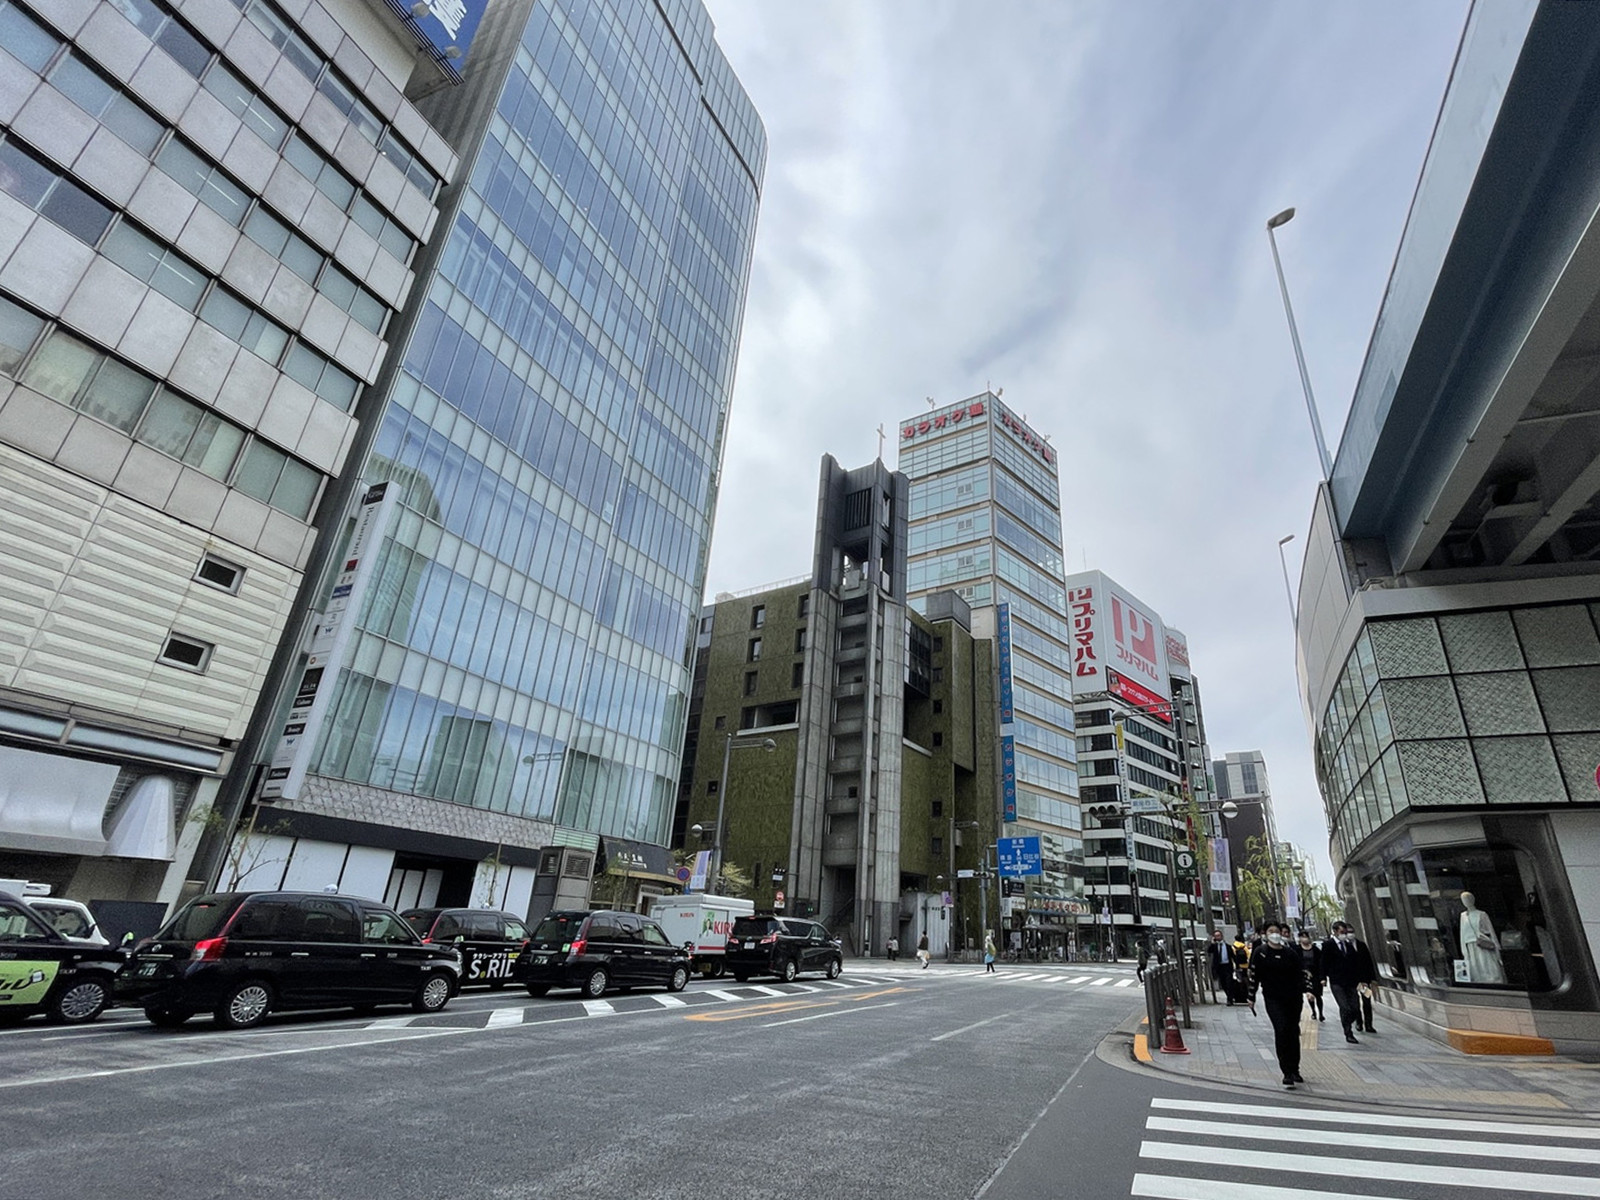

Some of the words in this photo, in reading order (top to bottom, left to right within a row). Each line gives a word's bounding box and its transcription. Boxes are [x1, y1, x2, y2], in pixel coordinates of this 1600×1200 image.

[903, 402, 984, 438] カラオケ館
[1001, 413, 1054, 463] カラオケ館
[1072, 602, 1097, 677] プリマハム
[1115, 643, 1159, 682] プリマハム
[473, 952, 507, 960] タクシーアプリ
